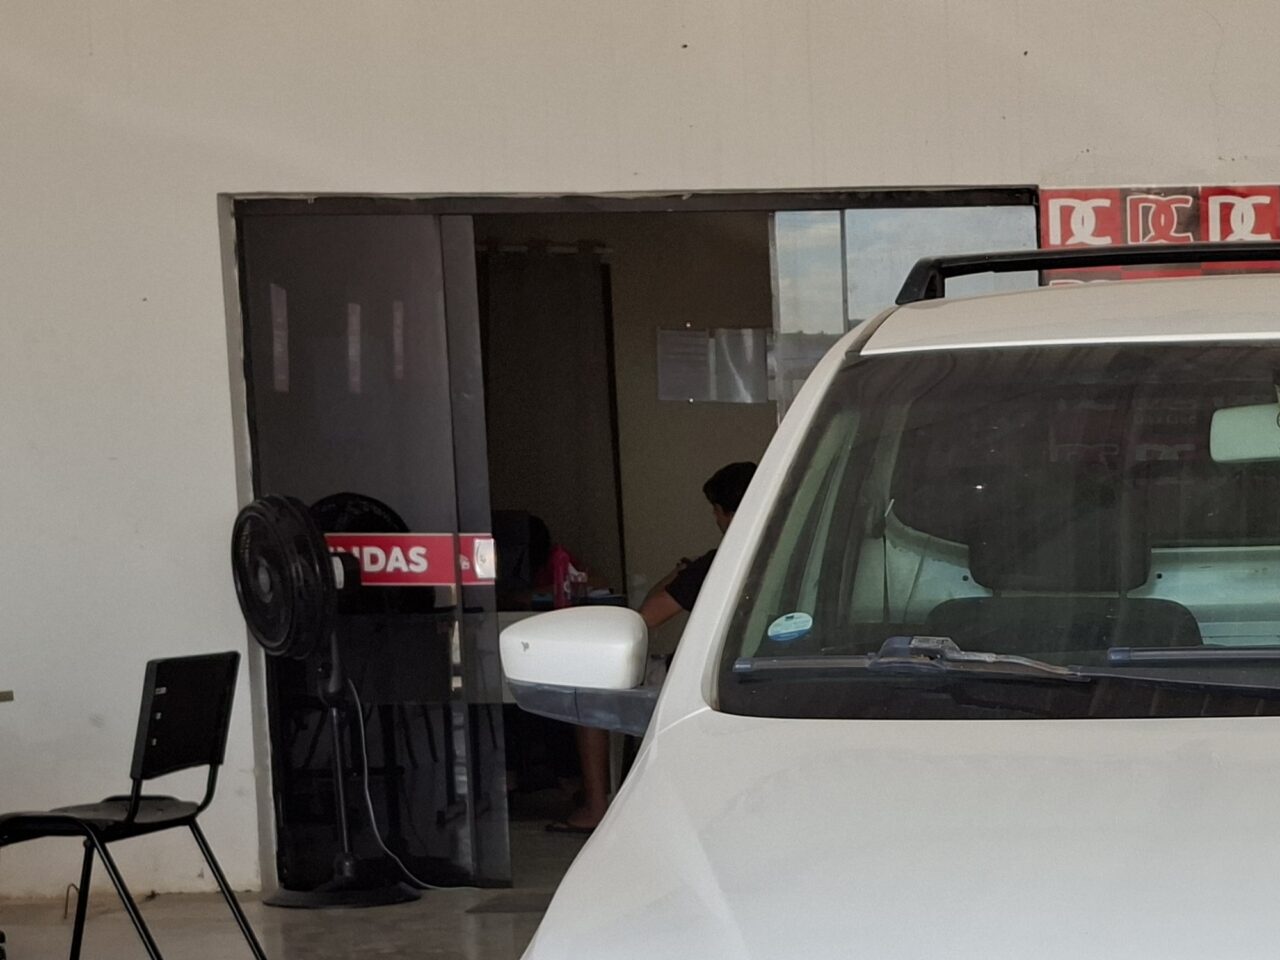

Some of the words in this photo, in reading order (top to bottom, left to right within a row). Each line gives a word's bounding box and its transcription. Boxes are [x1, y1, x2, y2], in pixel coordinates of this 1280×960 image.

[1048, 197, 1113, 245] DC
[1208, 192, 1272, 241] DC
[328, 546, 429, 572] DAS
